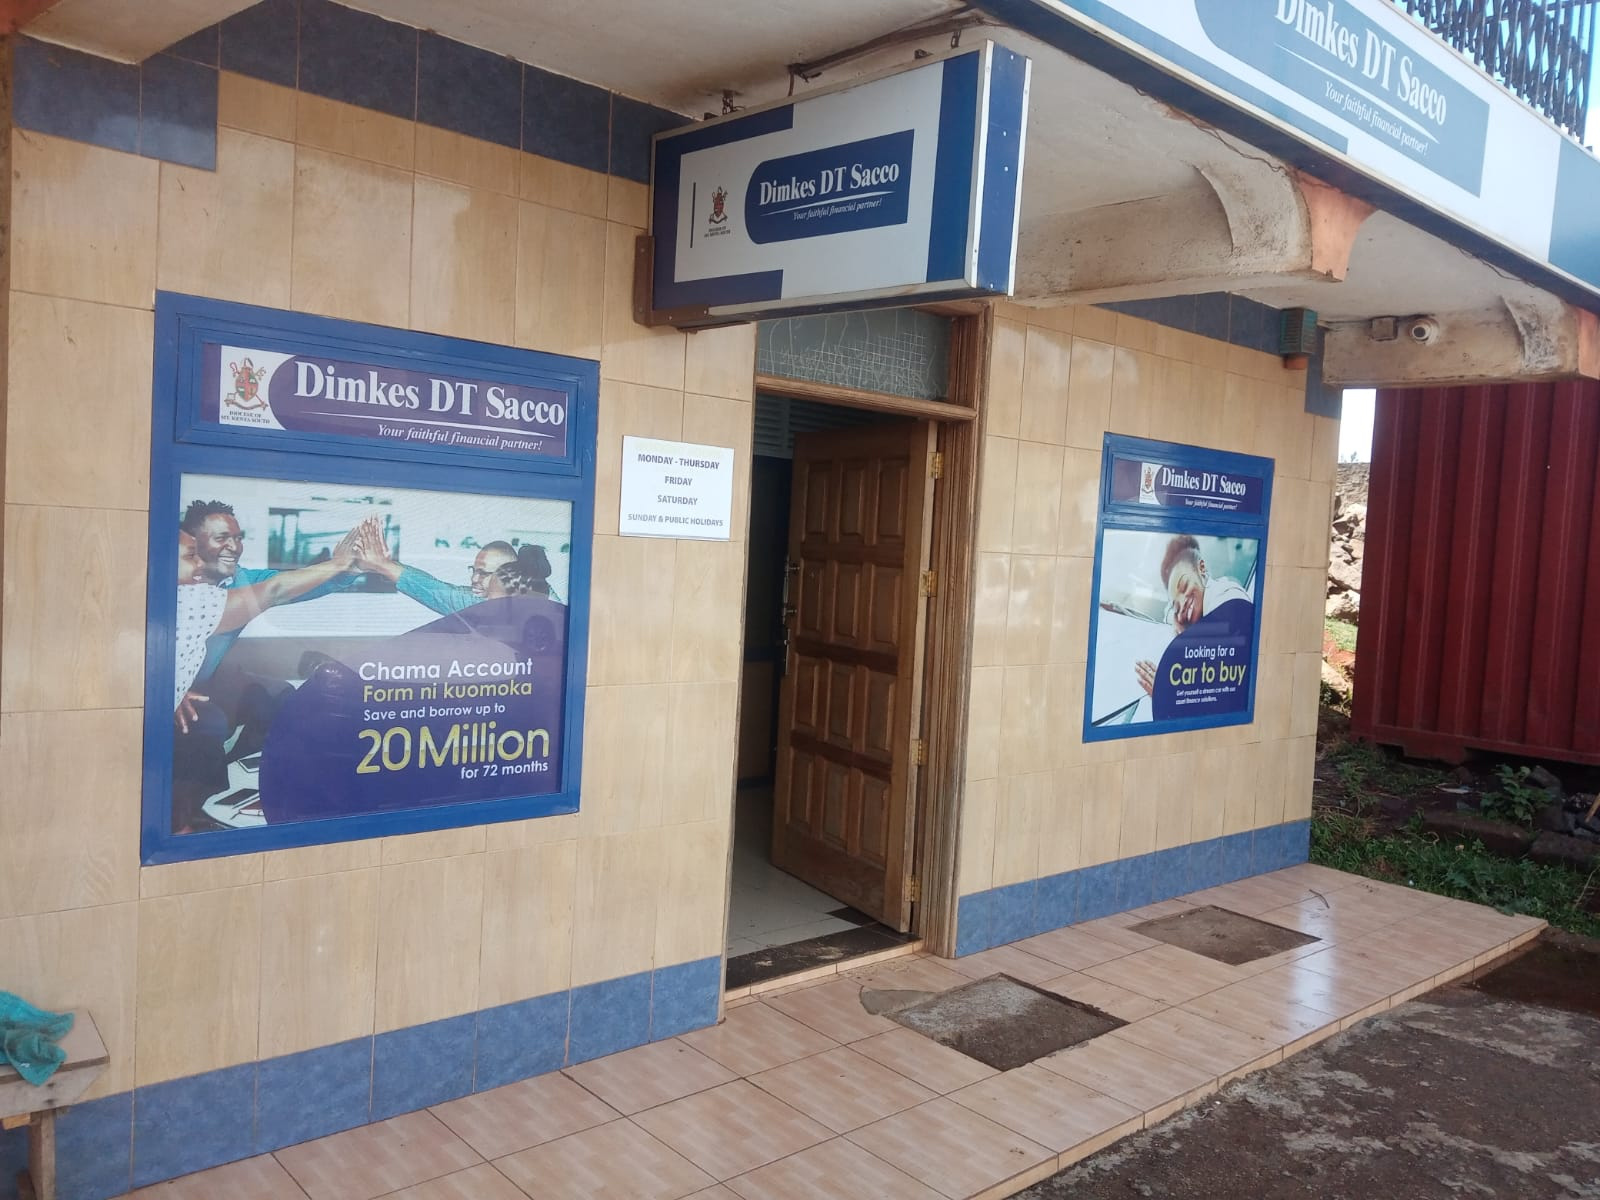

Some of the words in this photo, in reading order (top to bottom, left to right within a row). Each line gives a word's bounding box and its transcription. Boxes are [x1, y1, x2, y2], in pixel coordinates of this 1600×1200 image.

[1362, 28, 1396, 91] DT
[1397, 56, 1446, 125] Sacco
[1325, 81, 1344, 104] Your
[1342, 94, 1373, 121] faithful
[1370, 111, 1402, 140] financial
[1400, 132, 1428, 155] partner!
[759, 175, 816, 205] Dimkes
[820, 166, 847, 194] DT
[850, 163, 899, 189] Sacco
[793, 211, 807, 221] Your
[806, 207, 829, 220] faithful
[829, 202, 856, 216] financial
[856, 198, 883, 212] partner!
[294, 361, 420, 409] Dimkes
[429, 379, 478, 415] DT
[486, 386, 564, 426] Sacco
[377, 424, 404, 437] Your
[405, 427, 449, 443] faithful
[449, 431, 500, 447] financial
[500, 439, 543, 450] partner!
[638, 454, 674, 465] MONDAY
[680, 458, 720, 469] THURSDAY
[664, 476, 693, 486] FRIDAY
[1162, 467, 1200, 490] Dimkes
[1202, 472, 1218, 492] DT
[1220, 475, 1246, 496] Sacco
[657, 494, 698, 505] SATURDAY
[628, 513, 656, 522] SUNDAY
[665, 516, 689, 524] PUBLIC
[690, 518, 723, 526] HOLIDAYS
[1185, 645, 1216, 660] Looking
[1217, 645, 1229, 657] for
[1229, 648, 1235, 656] a
[359, 662, 440, 681] Chama
[447, 658, 533, 677] Account
[1170, 663, 1198, 686] Car
[1201, 662, 1215, 683] to
[1220, 661, 1247, 685] buy
[363, 685, 413, 702] Form
[420, 683, 437, 699] ni
[444, 680, 532, 699] kuomoka
[364, 709, 396, 721] Save
[400, 707, 425, 719] and
[429, 704, 472, 717] borrow
[476, 705, 491, 716] up
[494, 703, 506, 713] to
[356, 727, 412, 774] 20
[419, 721, 549, 768] Million
[461, 767, 479, 779] for
[483, 765, 498, 777] 72
[502, 761, 549, 776] months
